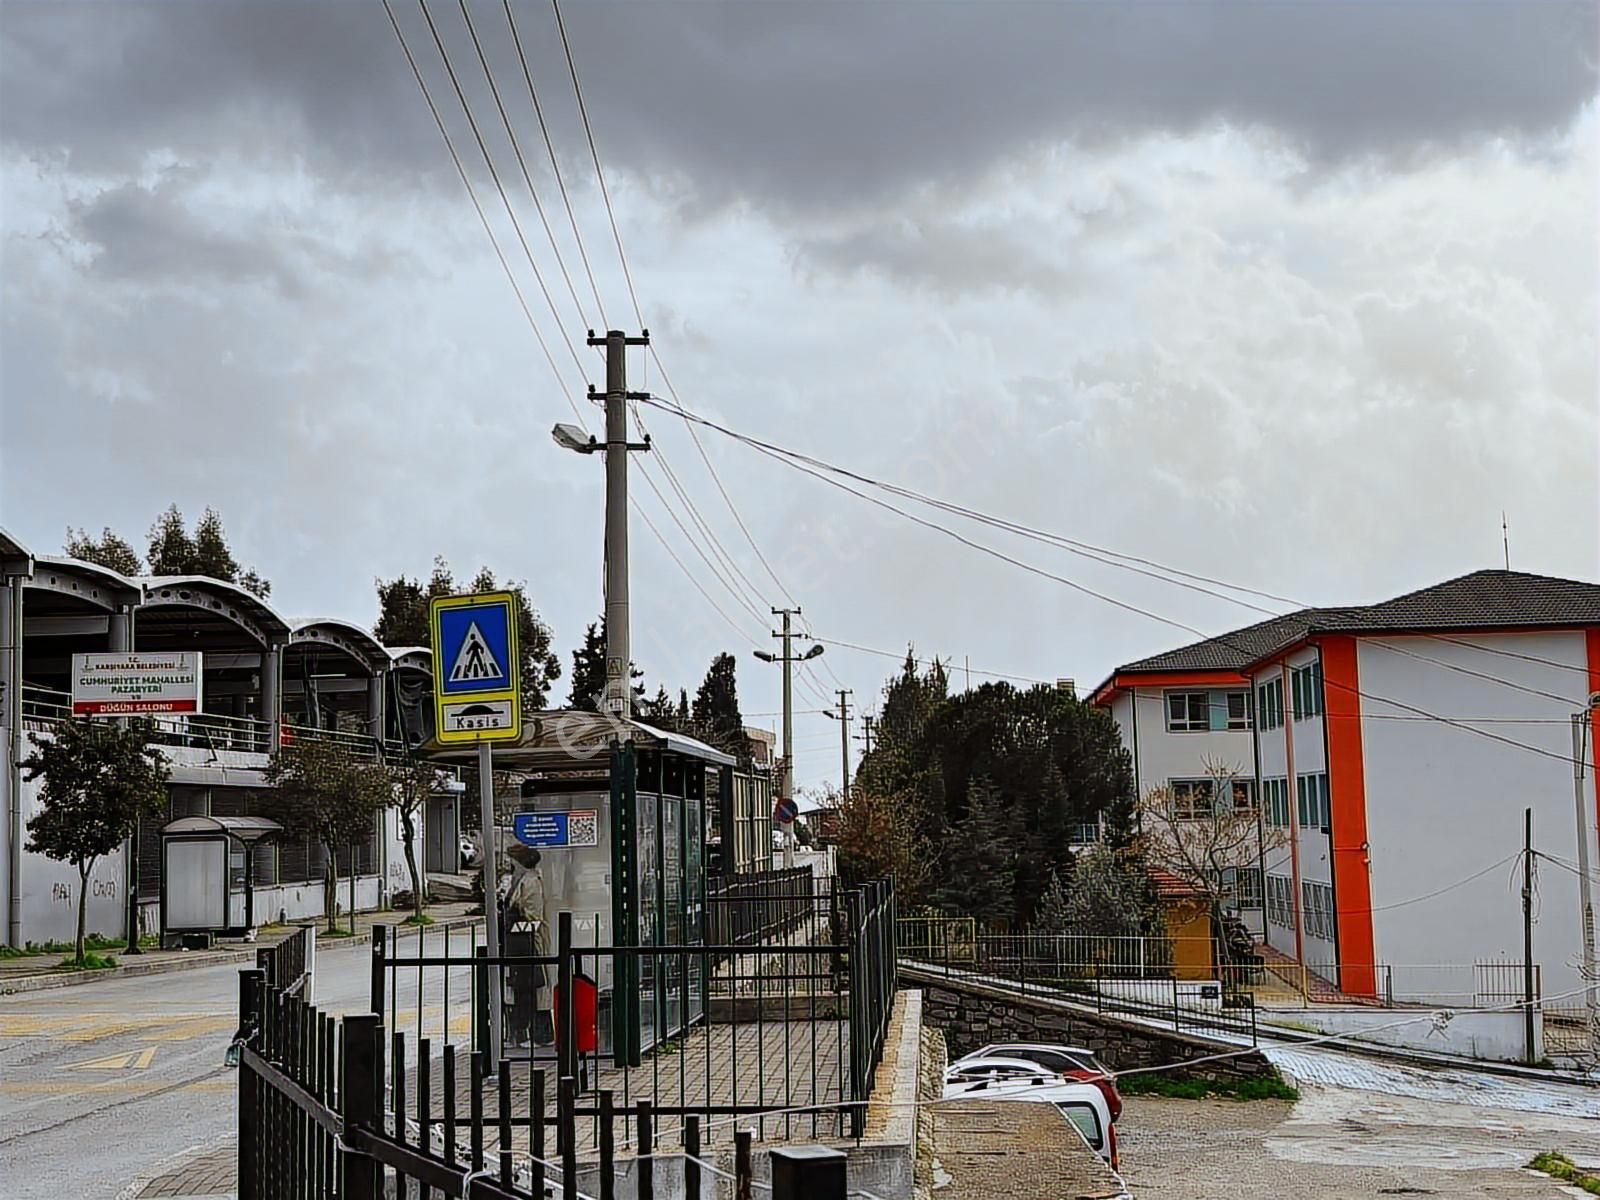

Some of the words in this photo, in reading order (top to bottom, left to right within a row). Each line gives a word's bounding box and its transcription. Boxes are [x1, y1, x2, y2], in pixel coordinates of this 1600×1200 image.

[95, 663, 134, 671] KARŞIYAKA
[136, 662, 175, 670] BELEDİYESİ
[80, 675, 139, 685] CUMHURİYET
[142, 674, 194, 684] MAHALLESİ
[111, 685, 162, 693] PAZARYERİ
[100, 702, 133, 712] DÜĞÜN
[136, 703, 173, 711] SALONU
[456, 716, 499, 729] Kasis
